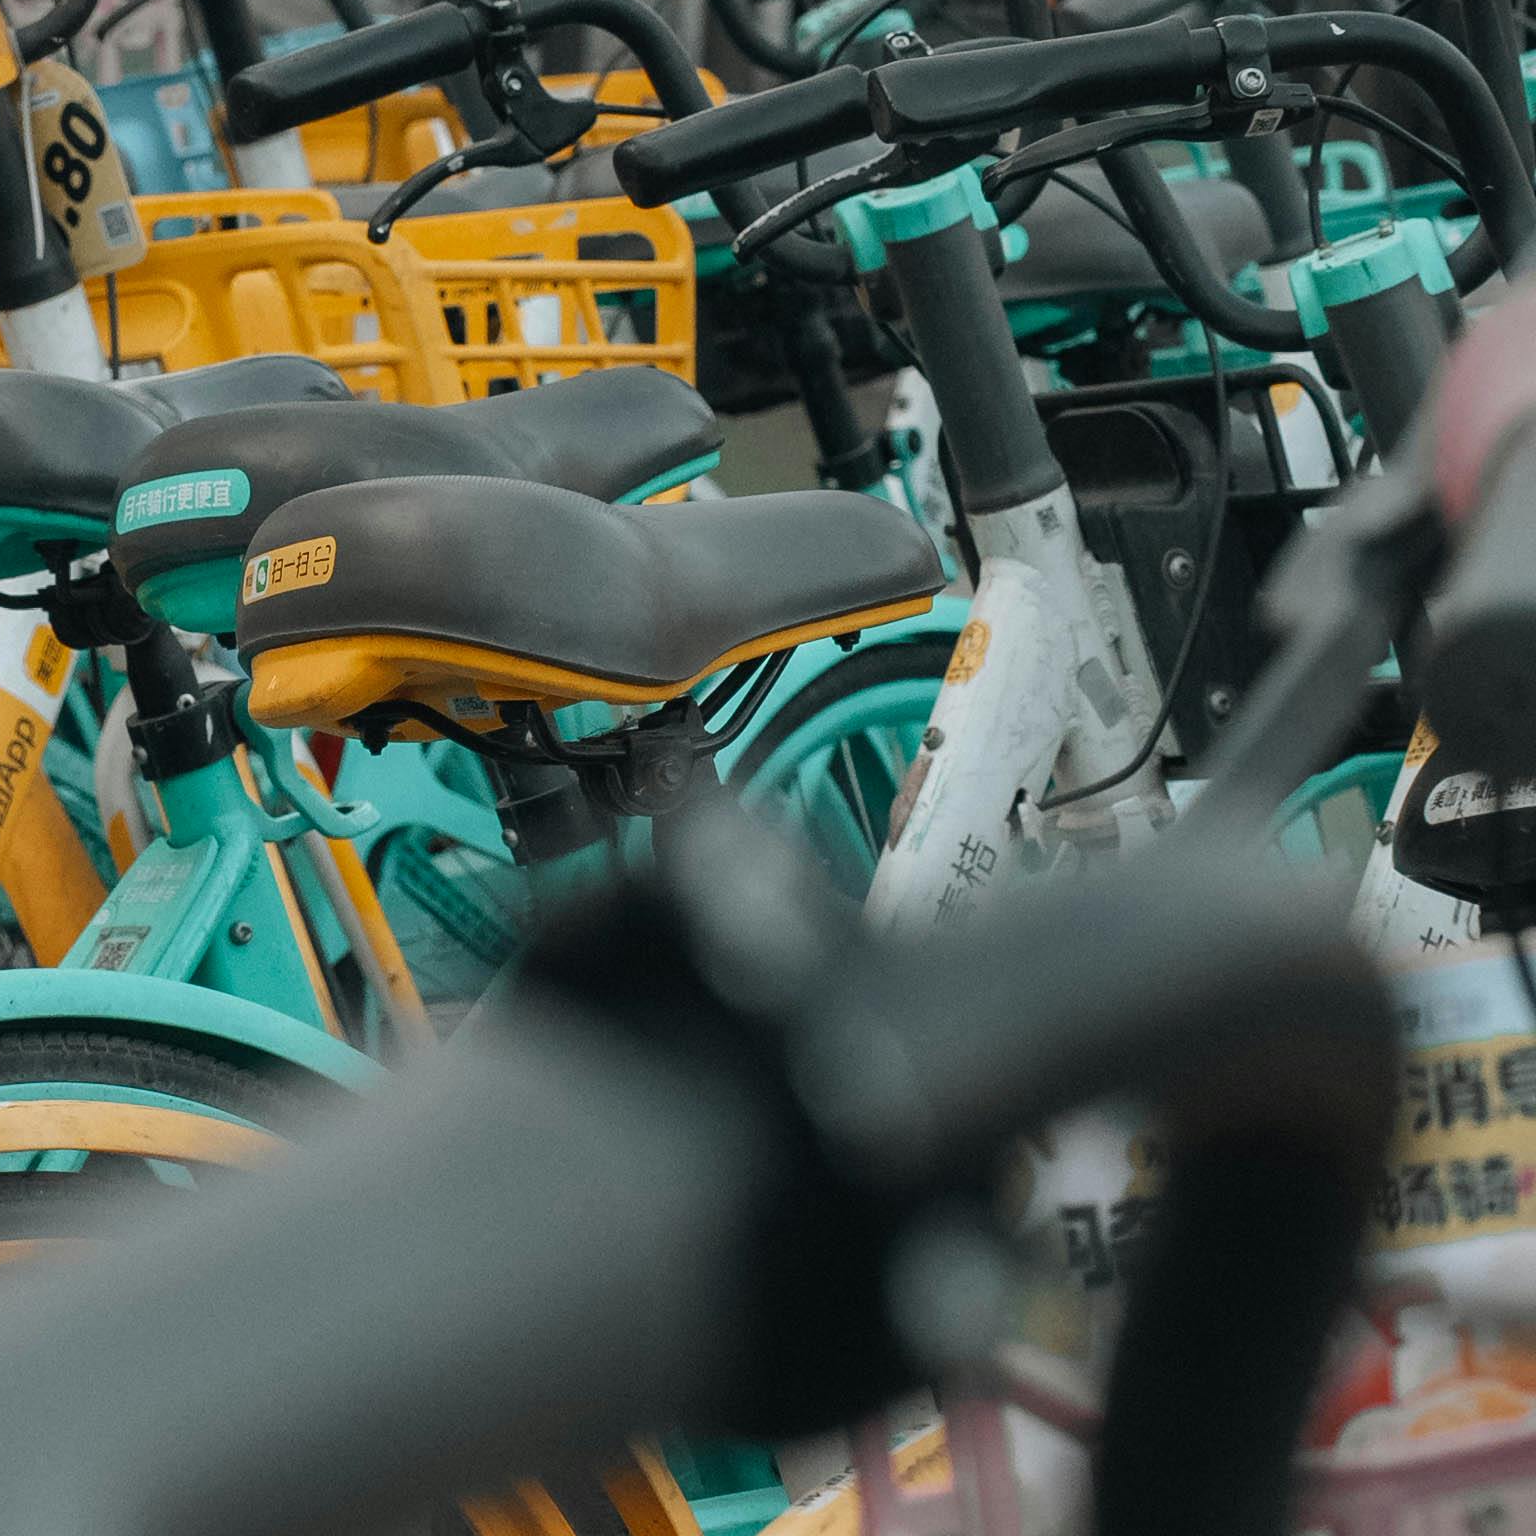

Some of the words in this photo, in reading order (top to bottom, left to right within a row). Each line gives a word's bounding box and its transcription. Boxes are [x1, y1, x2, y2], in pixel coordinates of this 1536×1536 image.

[124, 480, 231, 523] 月卡骑行更便宜
[272, 552, 310, 584] 扫一扫
